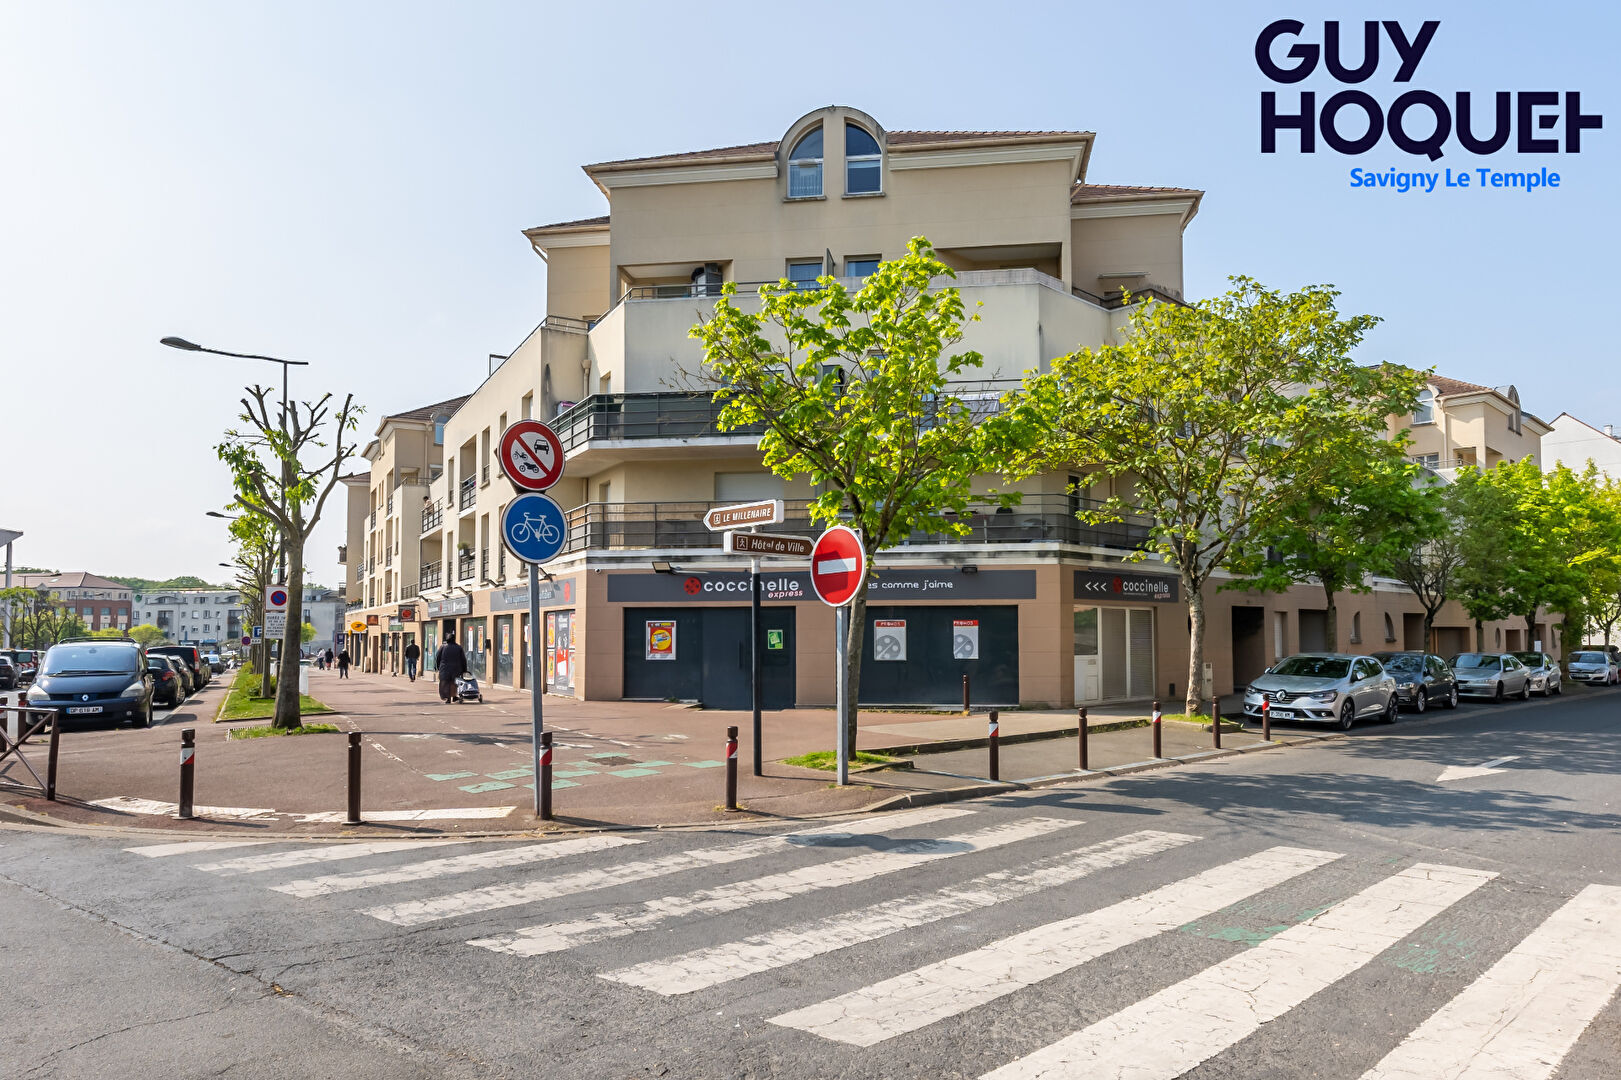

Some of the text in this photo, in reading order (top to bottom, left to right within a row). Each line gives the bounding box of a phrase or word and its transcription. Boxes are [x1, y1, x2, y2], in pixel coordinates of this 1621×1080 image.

[723, 507, 771, 523] LE MILLENAIRE
[751, 538, 805, 553] Hôtel de Ville
[922, 579, 954, 591] j'aime
[1122, 579, 1169, 593] coccinelle
[767, 590, 804, 600] express
